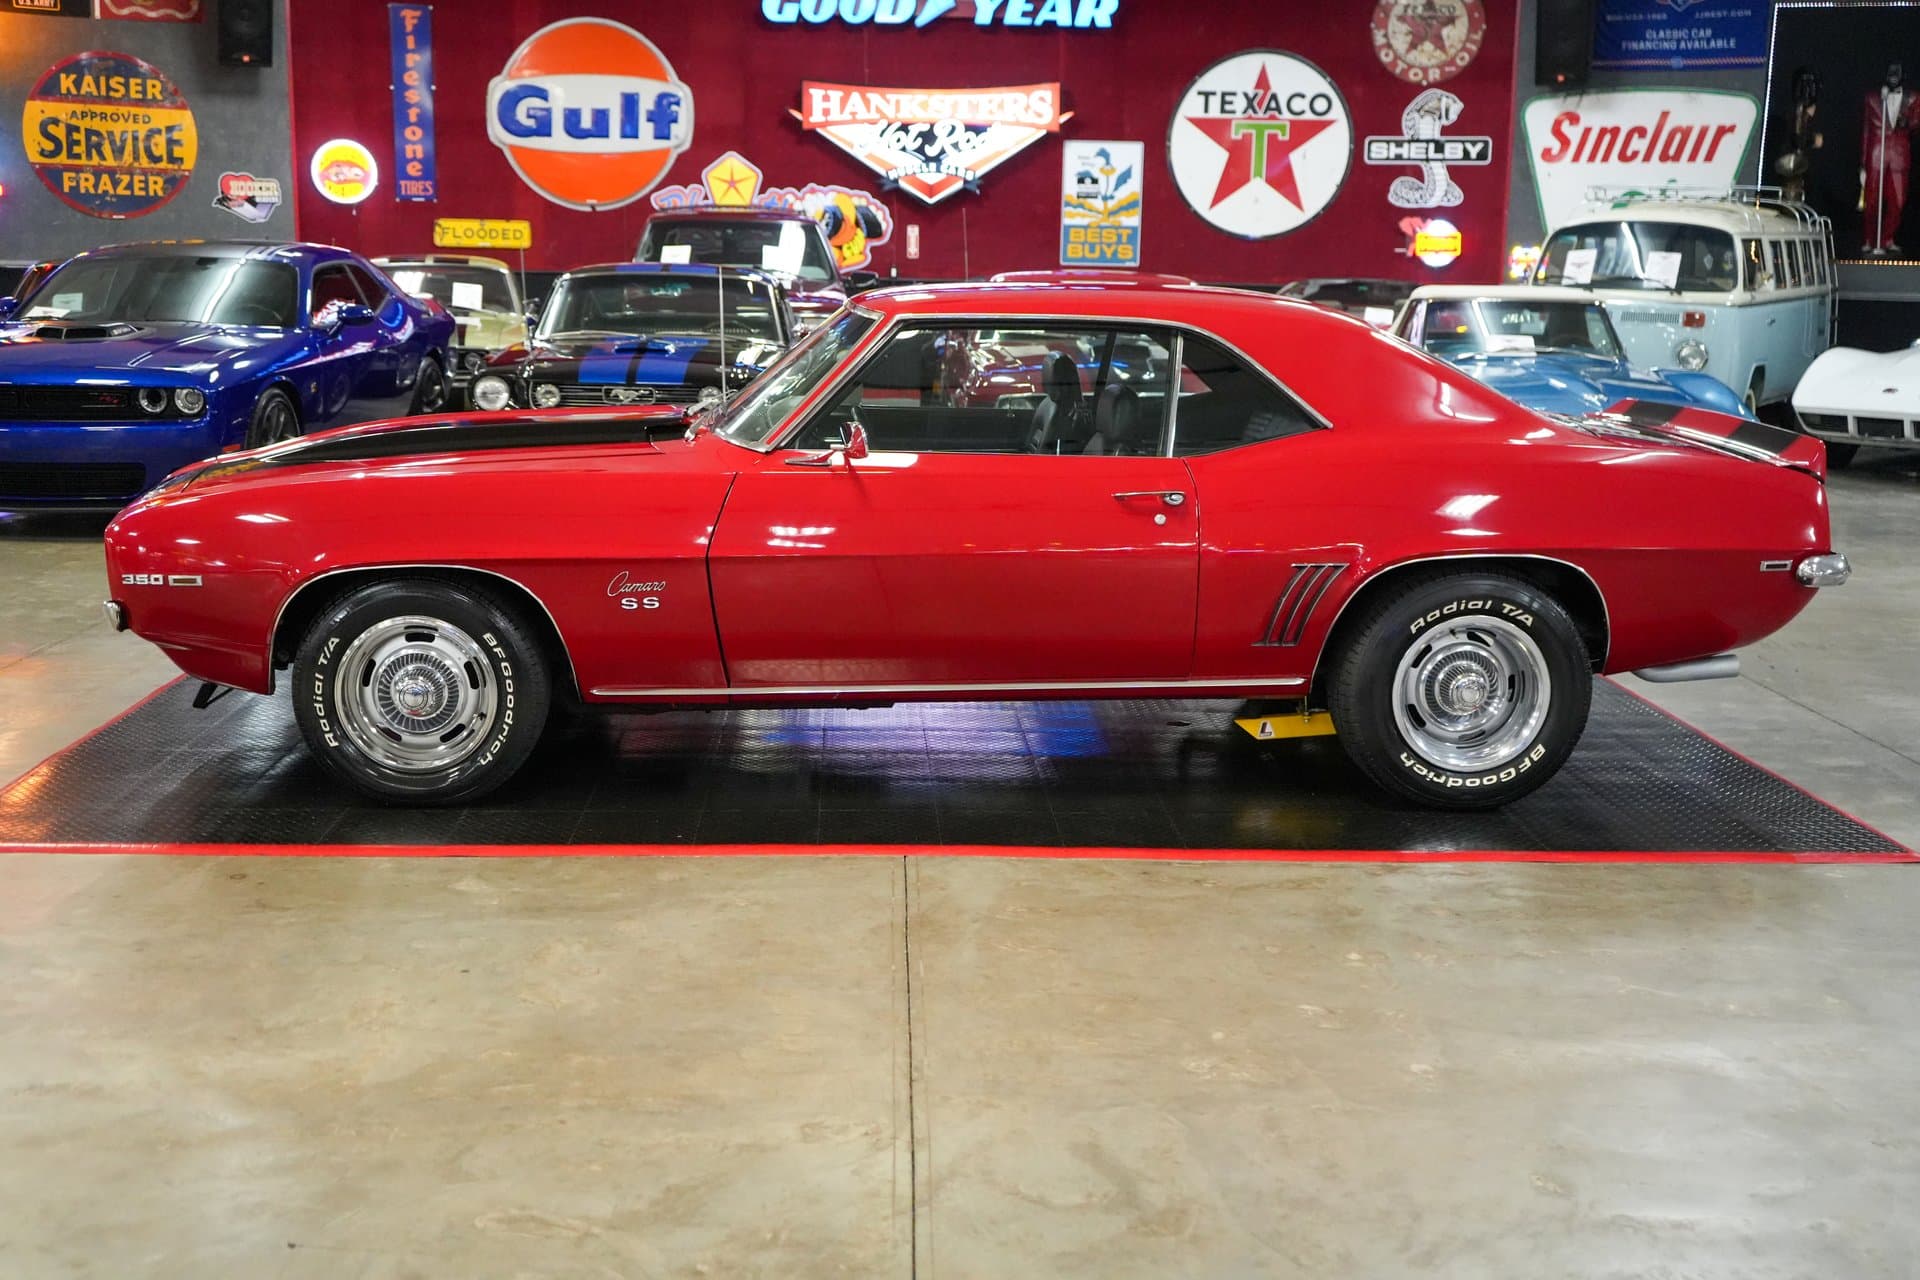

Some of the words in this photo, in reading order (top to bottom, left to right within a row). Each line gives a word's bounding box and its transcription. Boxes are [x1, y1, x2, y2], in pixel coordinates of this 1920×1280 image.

[1621, 39, 1677, 51] FINANCING
[1679, 37, 1737, 50] AVAILABLE
[1645, 28, 1689, 41] CLASSIC
[1691, 27, 1713, 39] CAR
[60, 73, 163, 100] KAISER
[400, 9, 424, 177] Firestone
[497, 84, 681, 140] Gulf
[808, 88, 1054, 124] HANKSTERS
[1197, 91, 1332, 116] TEXACO
[69, 110, 152, 125] APPROVED
[39, 116, 186, 165] SERVICE
[1541, 111, 1736, 163] Sinclair
[1369, 142, 1486, 159] SHELBY
[63, 172, 165, 197] FRAZER
[400, 180, 433, 196] TIRES
[442, 226, 524, 240] FLOODED
[1069, 227, 1133, 244] BEST
[1067, 243, 1134, 260] BUYS
[121, 574, 164, 585] 350
[607, 571, 666, 597] Camaro
[621, 597, 660, 609] SS
[1410, 600, 1492, 634] Radial
[1502, 603, 1535, 627] T/A
[318, 637, 340, 666] T/A
[313, 673, 339, 748] Radial
[479, 632, 515, 766] BFGoodrich
[1400, 744, 1546, 788] BFGoodrich
